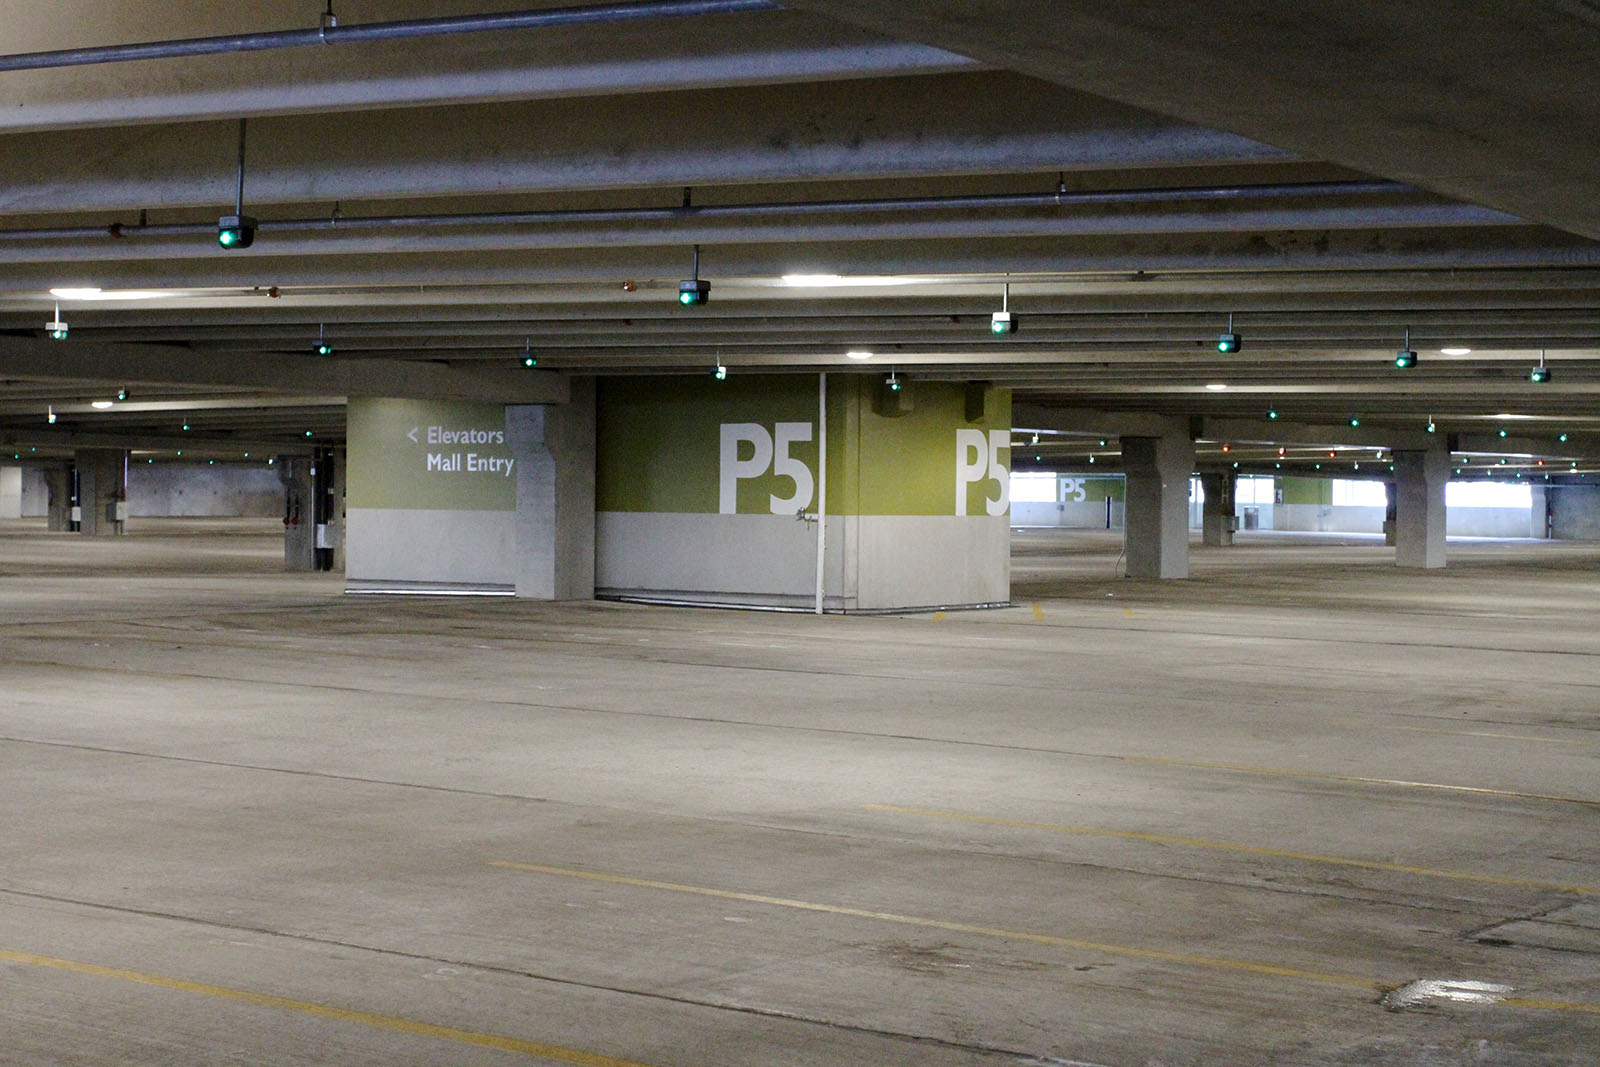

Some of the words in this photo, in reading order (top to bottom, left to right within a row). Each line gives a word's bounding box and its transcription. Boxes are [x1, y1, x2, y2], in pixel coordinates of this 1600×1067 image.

[427, 425, 504, 445] Elevators
[427, 453, 461, 472] Mall
[467, 453, 514, 477] Entry
[719, 421, 814, 516] P5
[955, 428, 1011, 517] P5
[1059, 480, 1086, 503] P5
